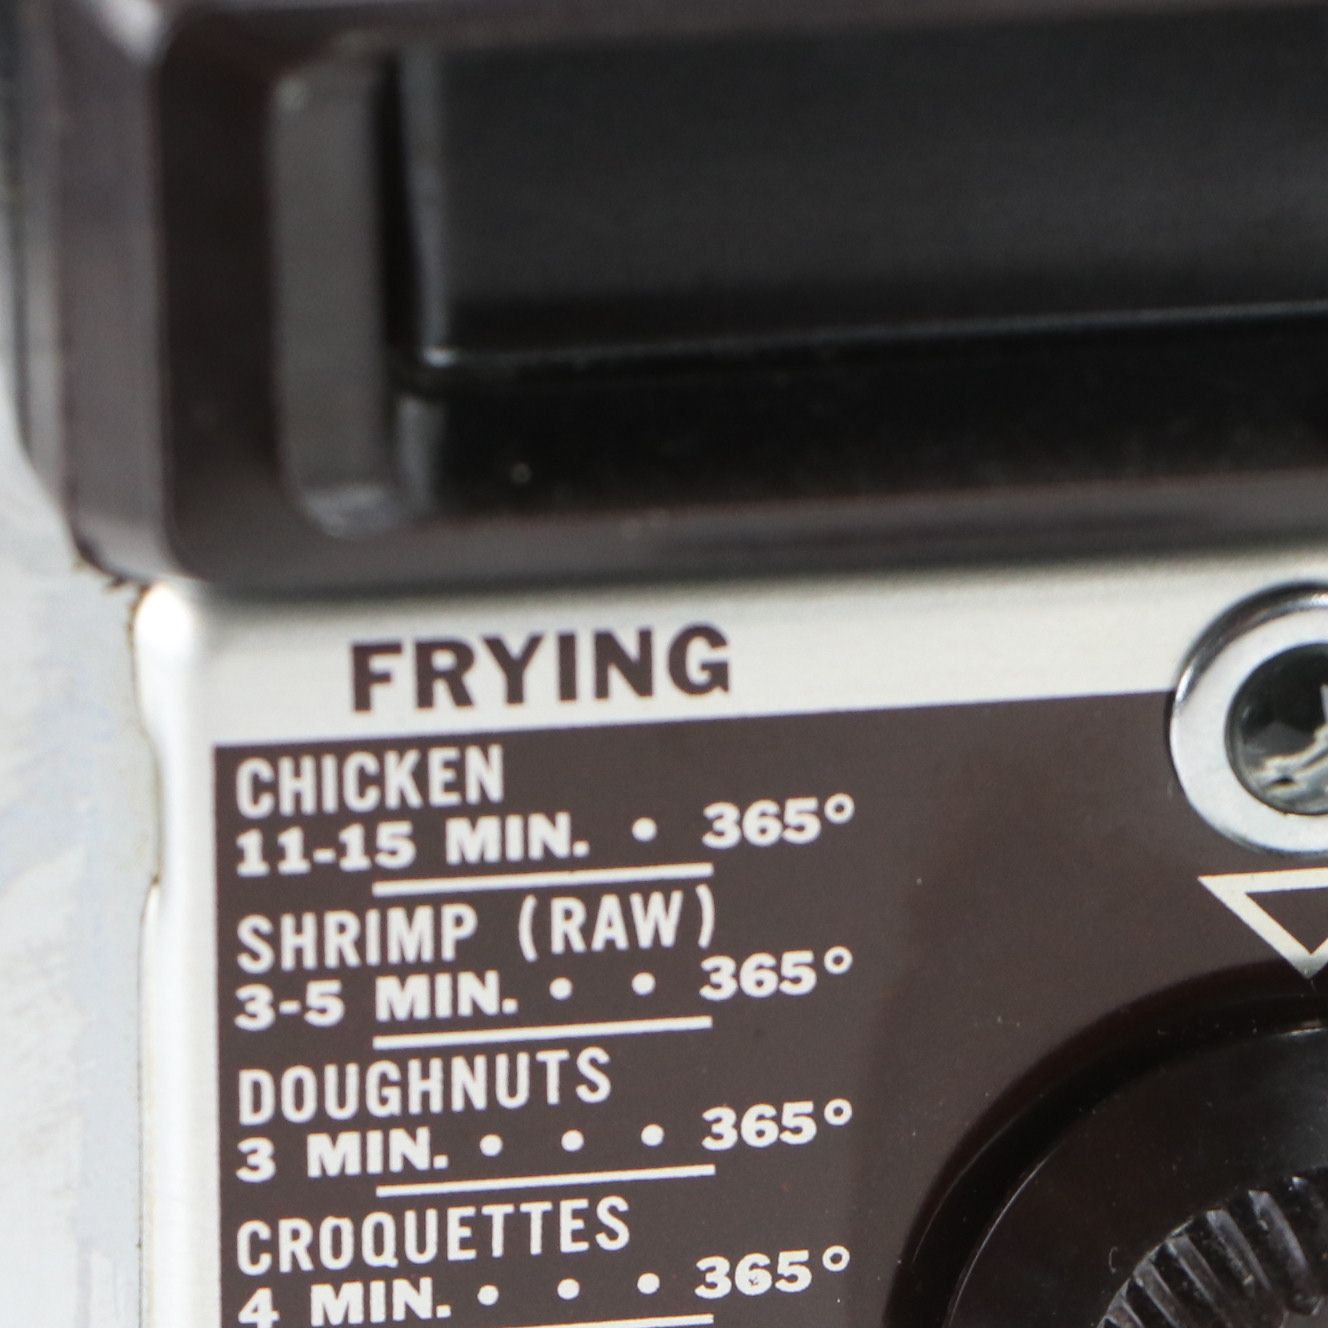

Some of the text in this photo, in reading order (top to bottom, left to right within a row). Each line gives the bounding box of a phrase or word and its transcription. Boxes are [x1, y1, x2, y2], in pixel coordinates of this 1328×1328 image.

[350, 623, 730, 712] FRYING
[236, 744, 503, 819] CHICKEN
[236, 820, 416, 877] 11-15
[446, 812, 589, 864] MIN.
[237, 884, 715, 974] SHRIMP (RAW)
[234, 979, 345, 1031] 3-5
[375, 970, 518, 1022] MIN.
[238, 1046, 611, 1126] DOUGHNUTS
[236, 1137, 276, 1183] 3
[307, 1126, 448, 1178] MIN.
[236, 1195, 630, 1276] CROQUETTES
[310, 1276, 451, 1327] MIN.
